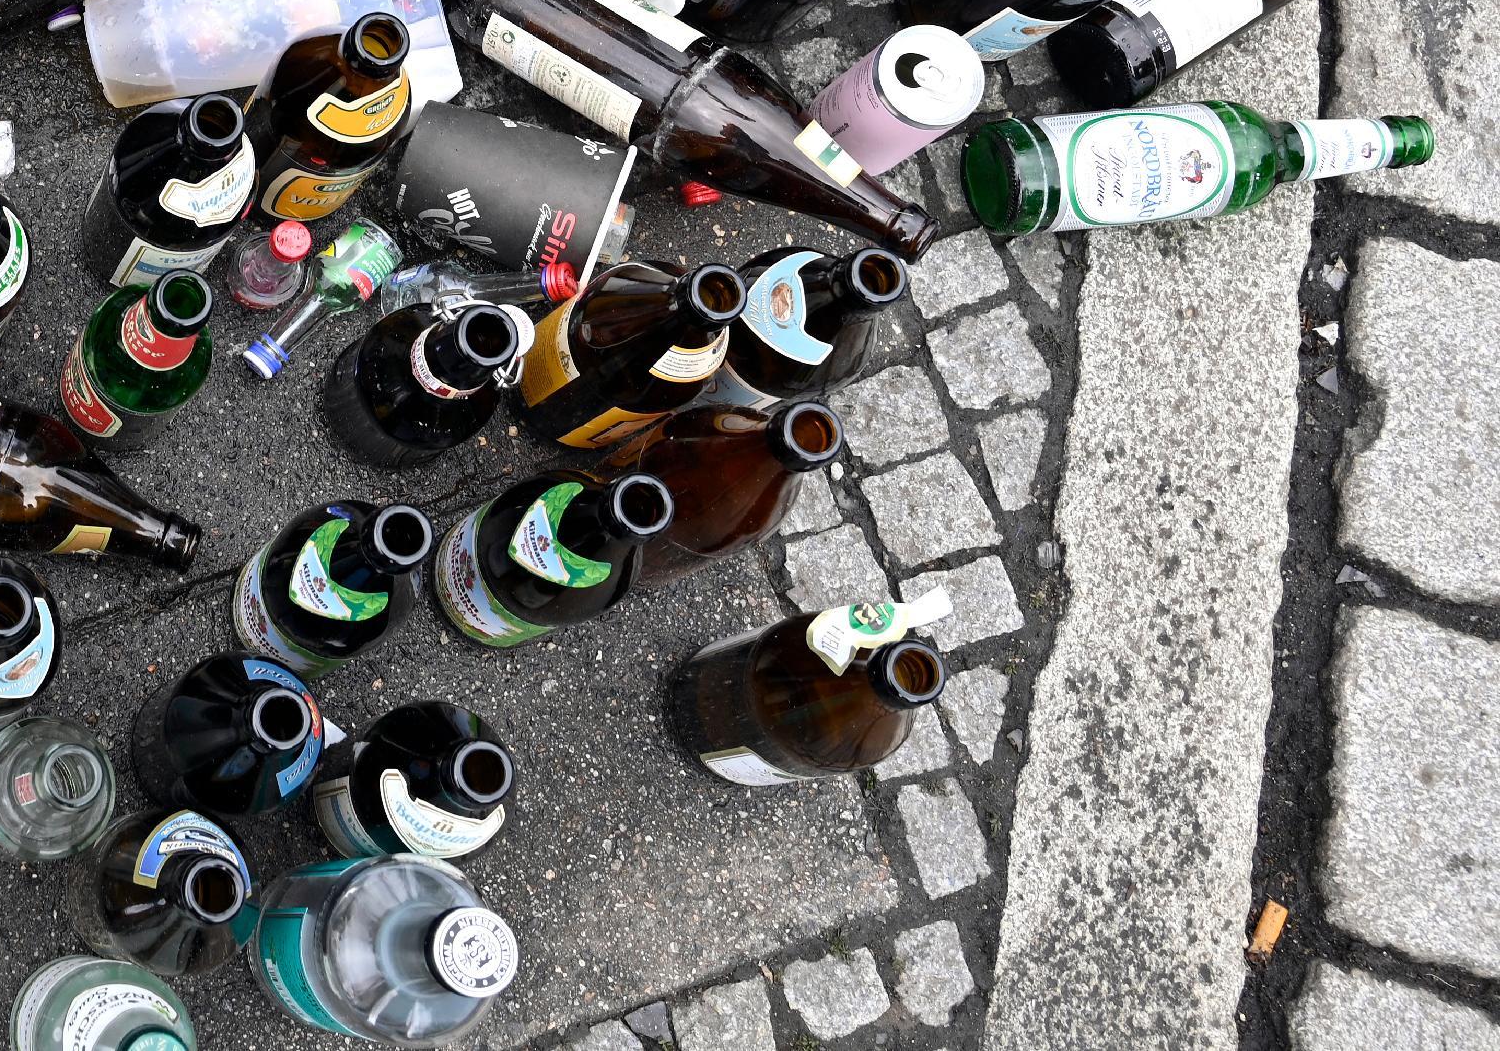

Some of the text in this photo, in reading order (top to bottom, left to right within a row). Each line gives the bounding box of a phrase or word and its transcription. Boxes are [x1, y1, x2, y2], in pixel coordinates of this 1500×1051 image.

[1129, 118, 1164, 219] NORDBRÄU
[446, 188, 480, 221] HOT
[529, 520, 548, 570] Kitzmann
[302, 562, 330, 611] Kitzmann
